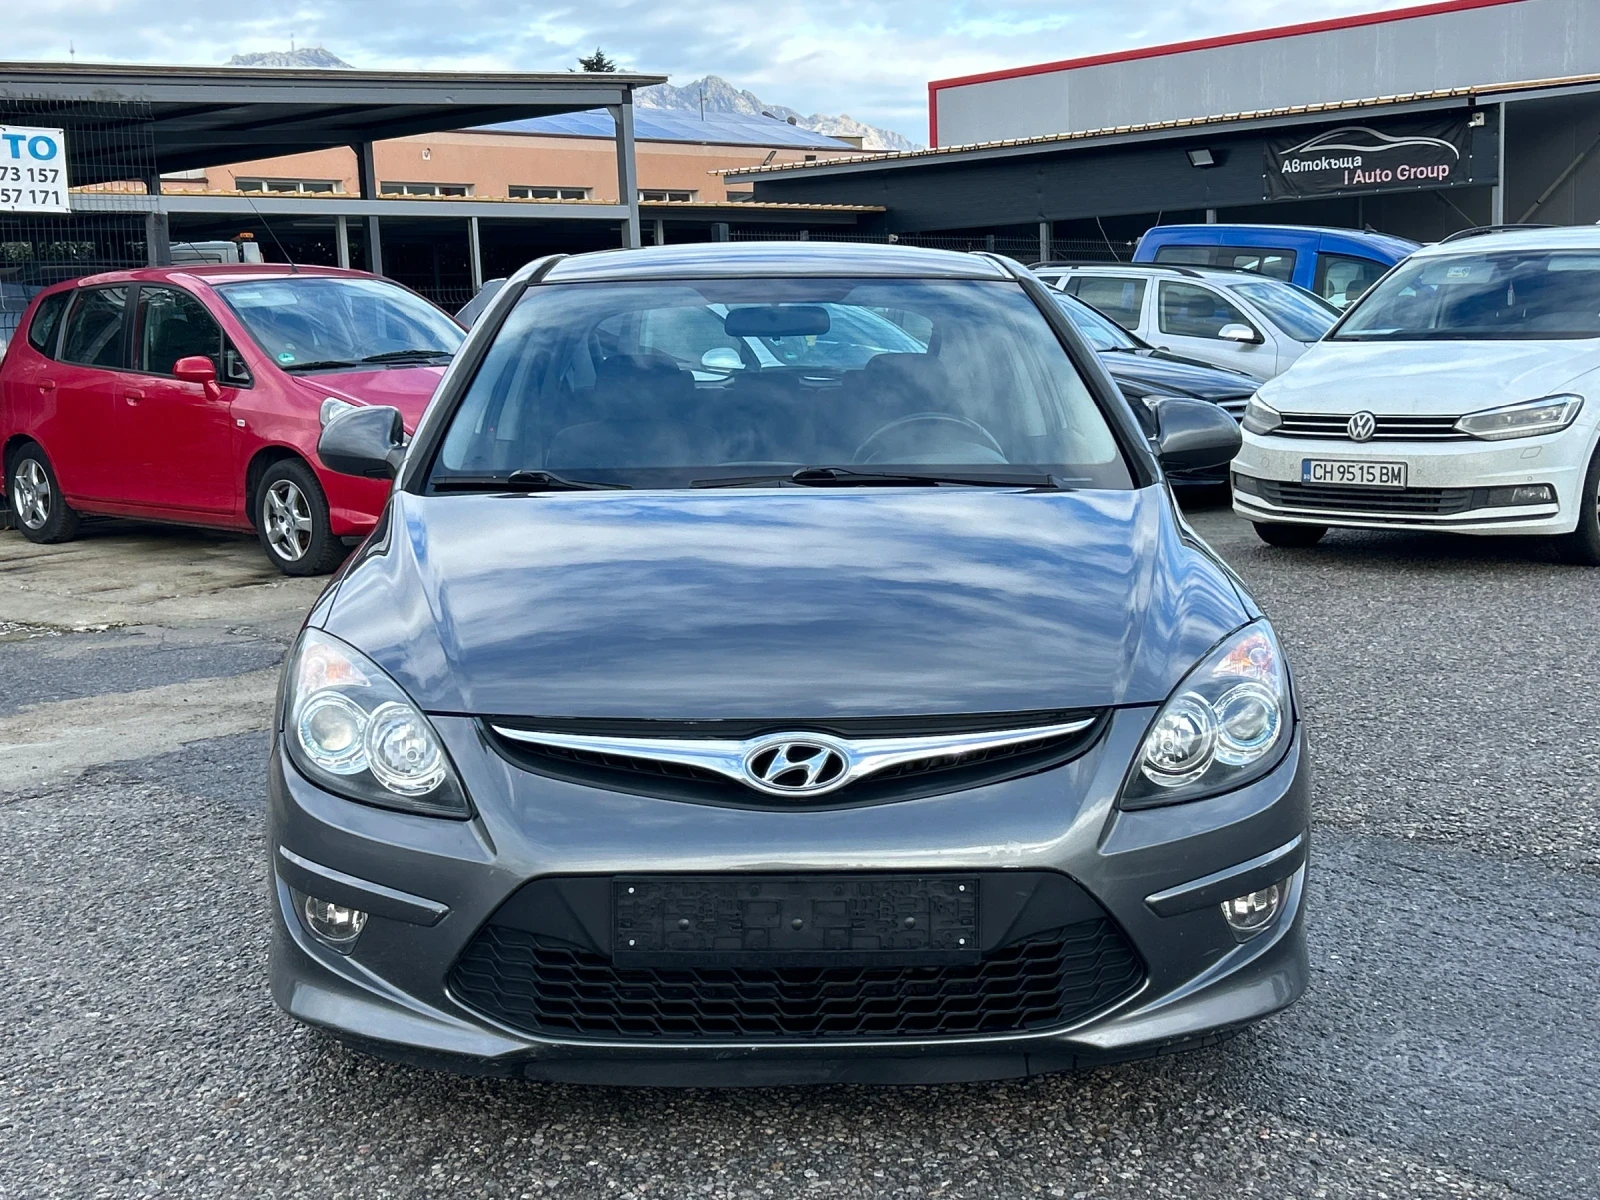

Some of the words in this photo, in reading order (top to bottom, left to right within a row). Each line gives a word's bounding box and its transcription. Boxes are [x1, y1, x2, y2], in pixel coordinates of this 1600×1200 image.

[2, 134, 57, 160] TO
[27, 168, 59, 183] 157
[1352, 167, 1393, 185] Auto
[1396, 164, 1450, 181] Group
[1, 188, 22, 203] 57
[29, 189, 59, 204] 171
[1313, 463, 1334, 481] CH
[1337, 464, 1376, 482] 9515
[1380, 466, 1402, 484] BM
